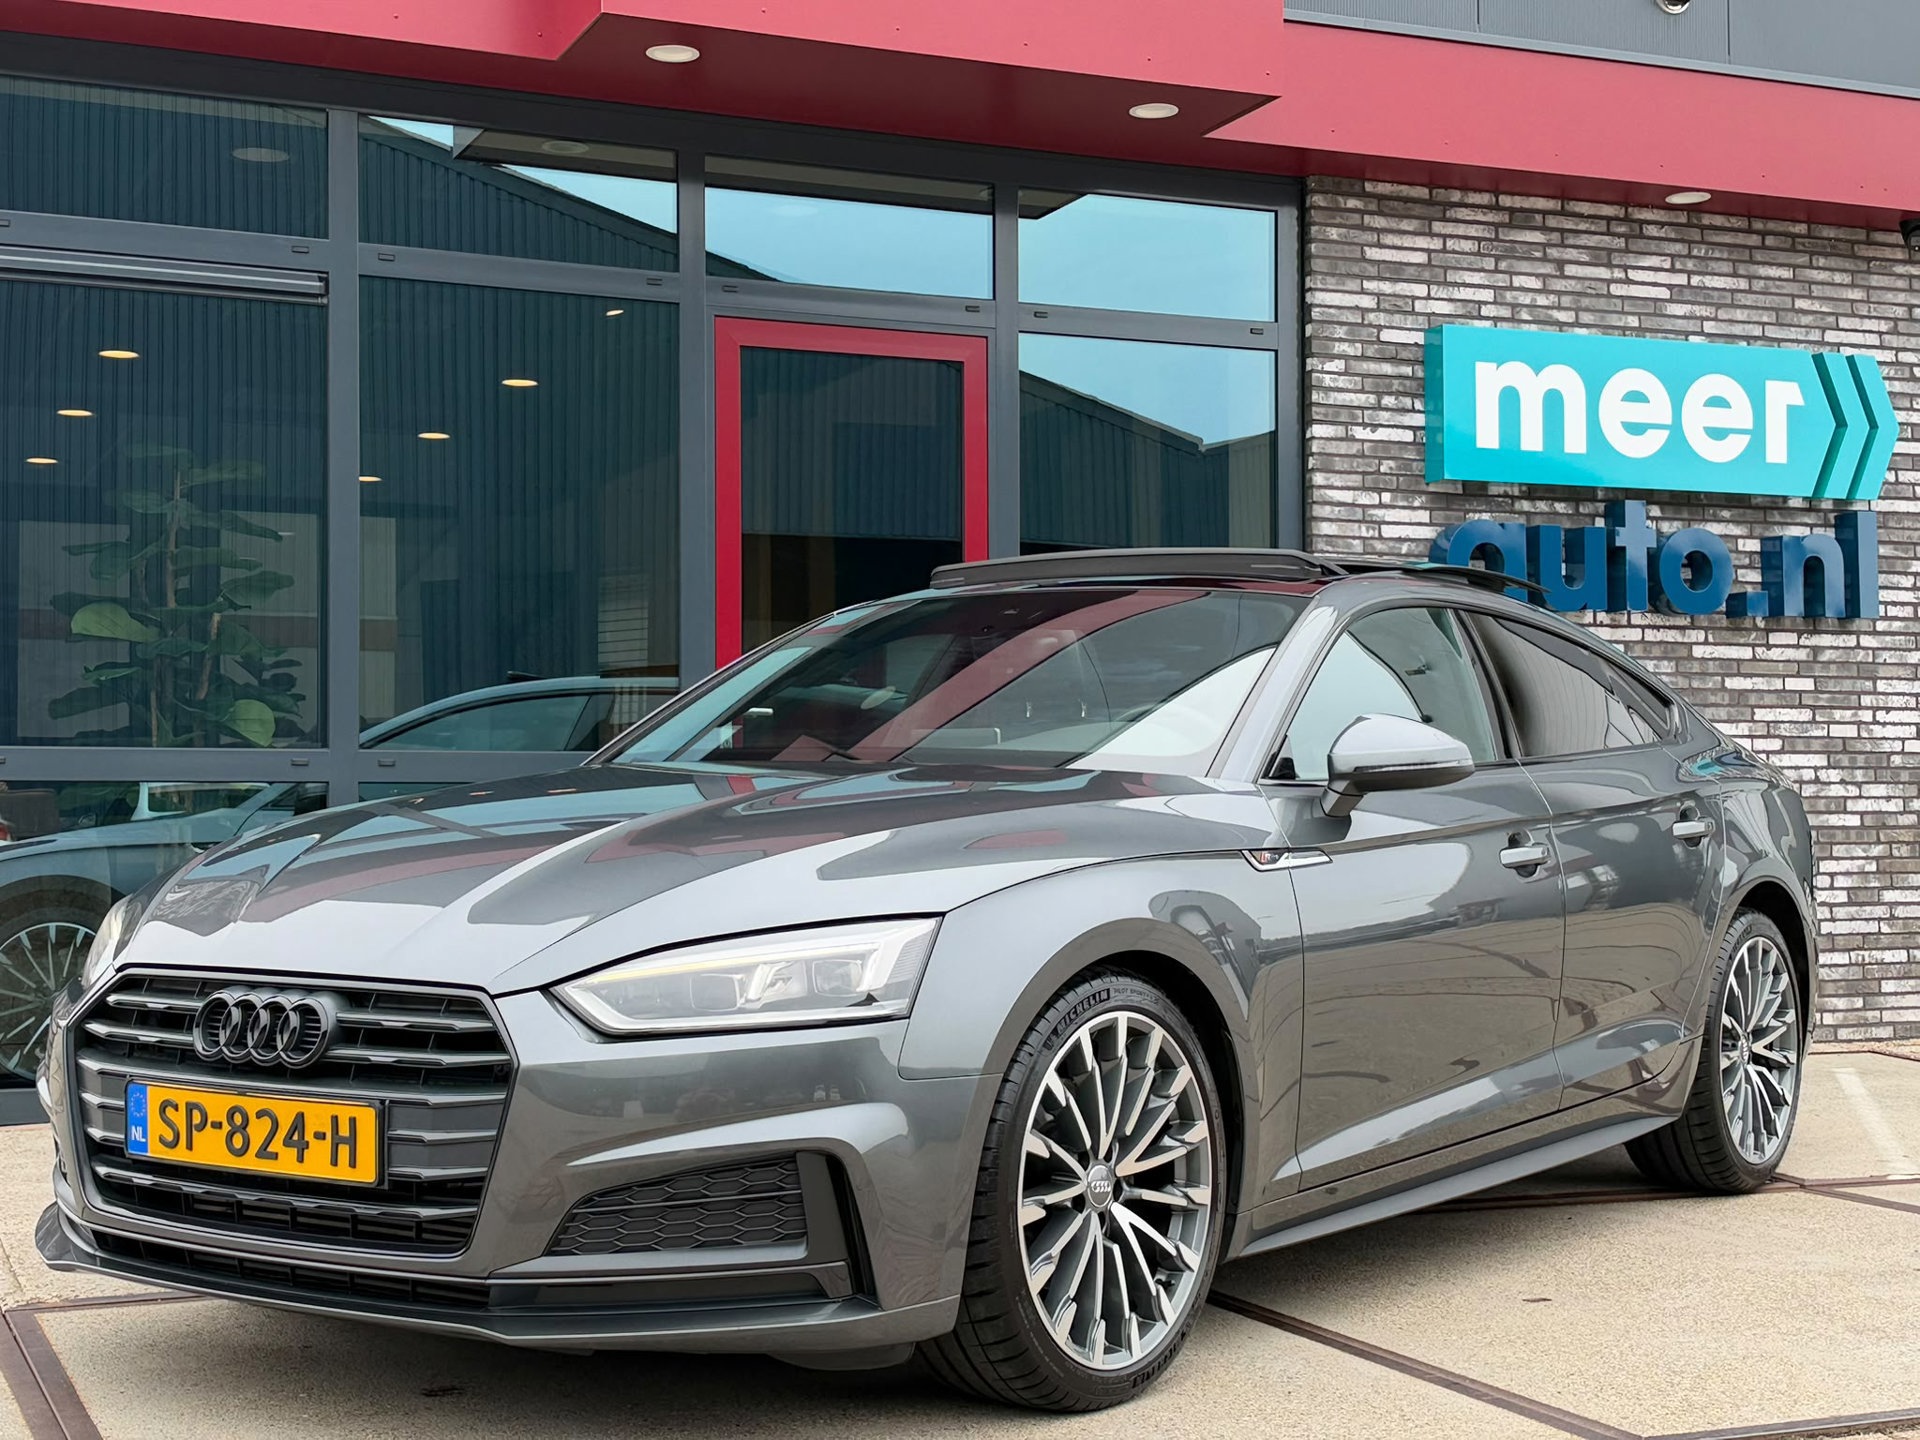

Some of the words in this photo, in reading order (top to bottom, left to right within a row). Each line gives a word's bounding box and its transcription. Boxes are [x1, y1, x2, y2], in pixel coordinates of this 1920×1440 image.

[1475, 360, 1806, 464] meer
[1431, 500, 1878, 619] auto.nl
[1057, 988, 1110, 1036] MICHELIN
[131, 1125, 146, 1142] NL
[158, 1098, 357, 1169] SP-824-H
